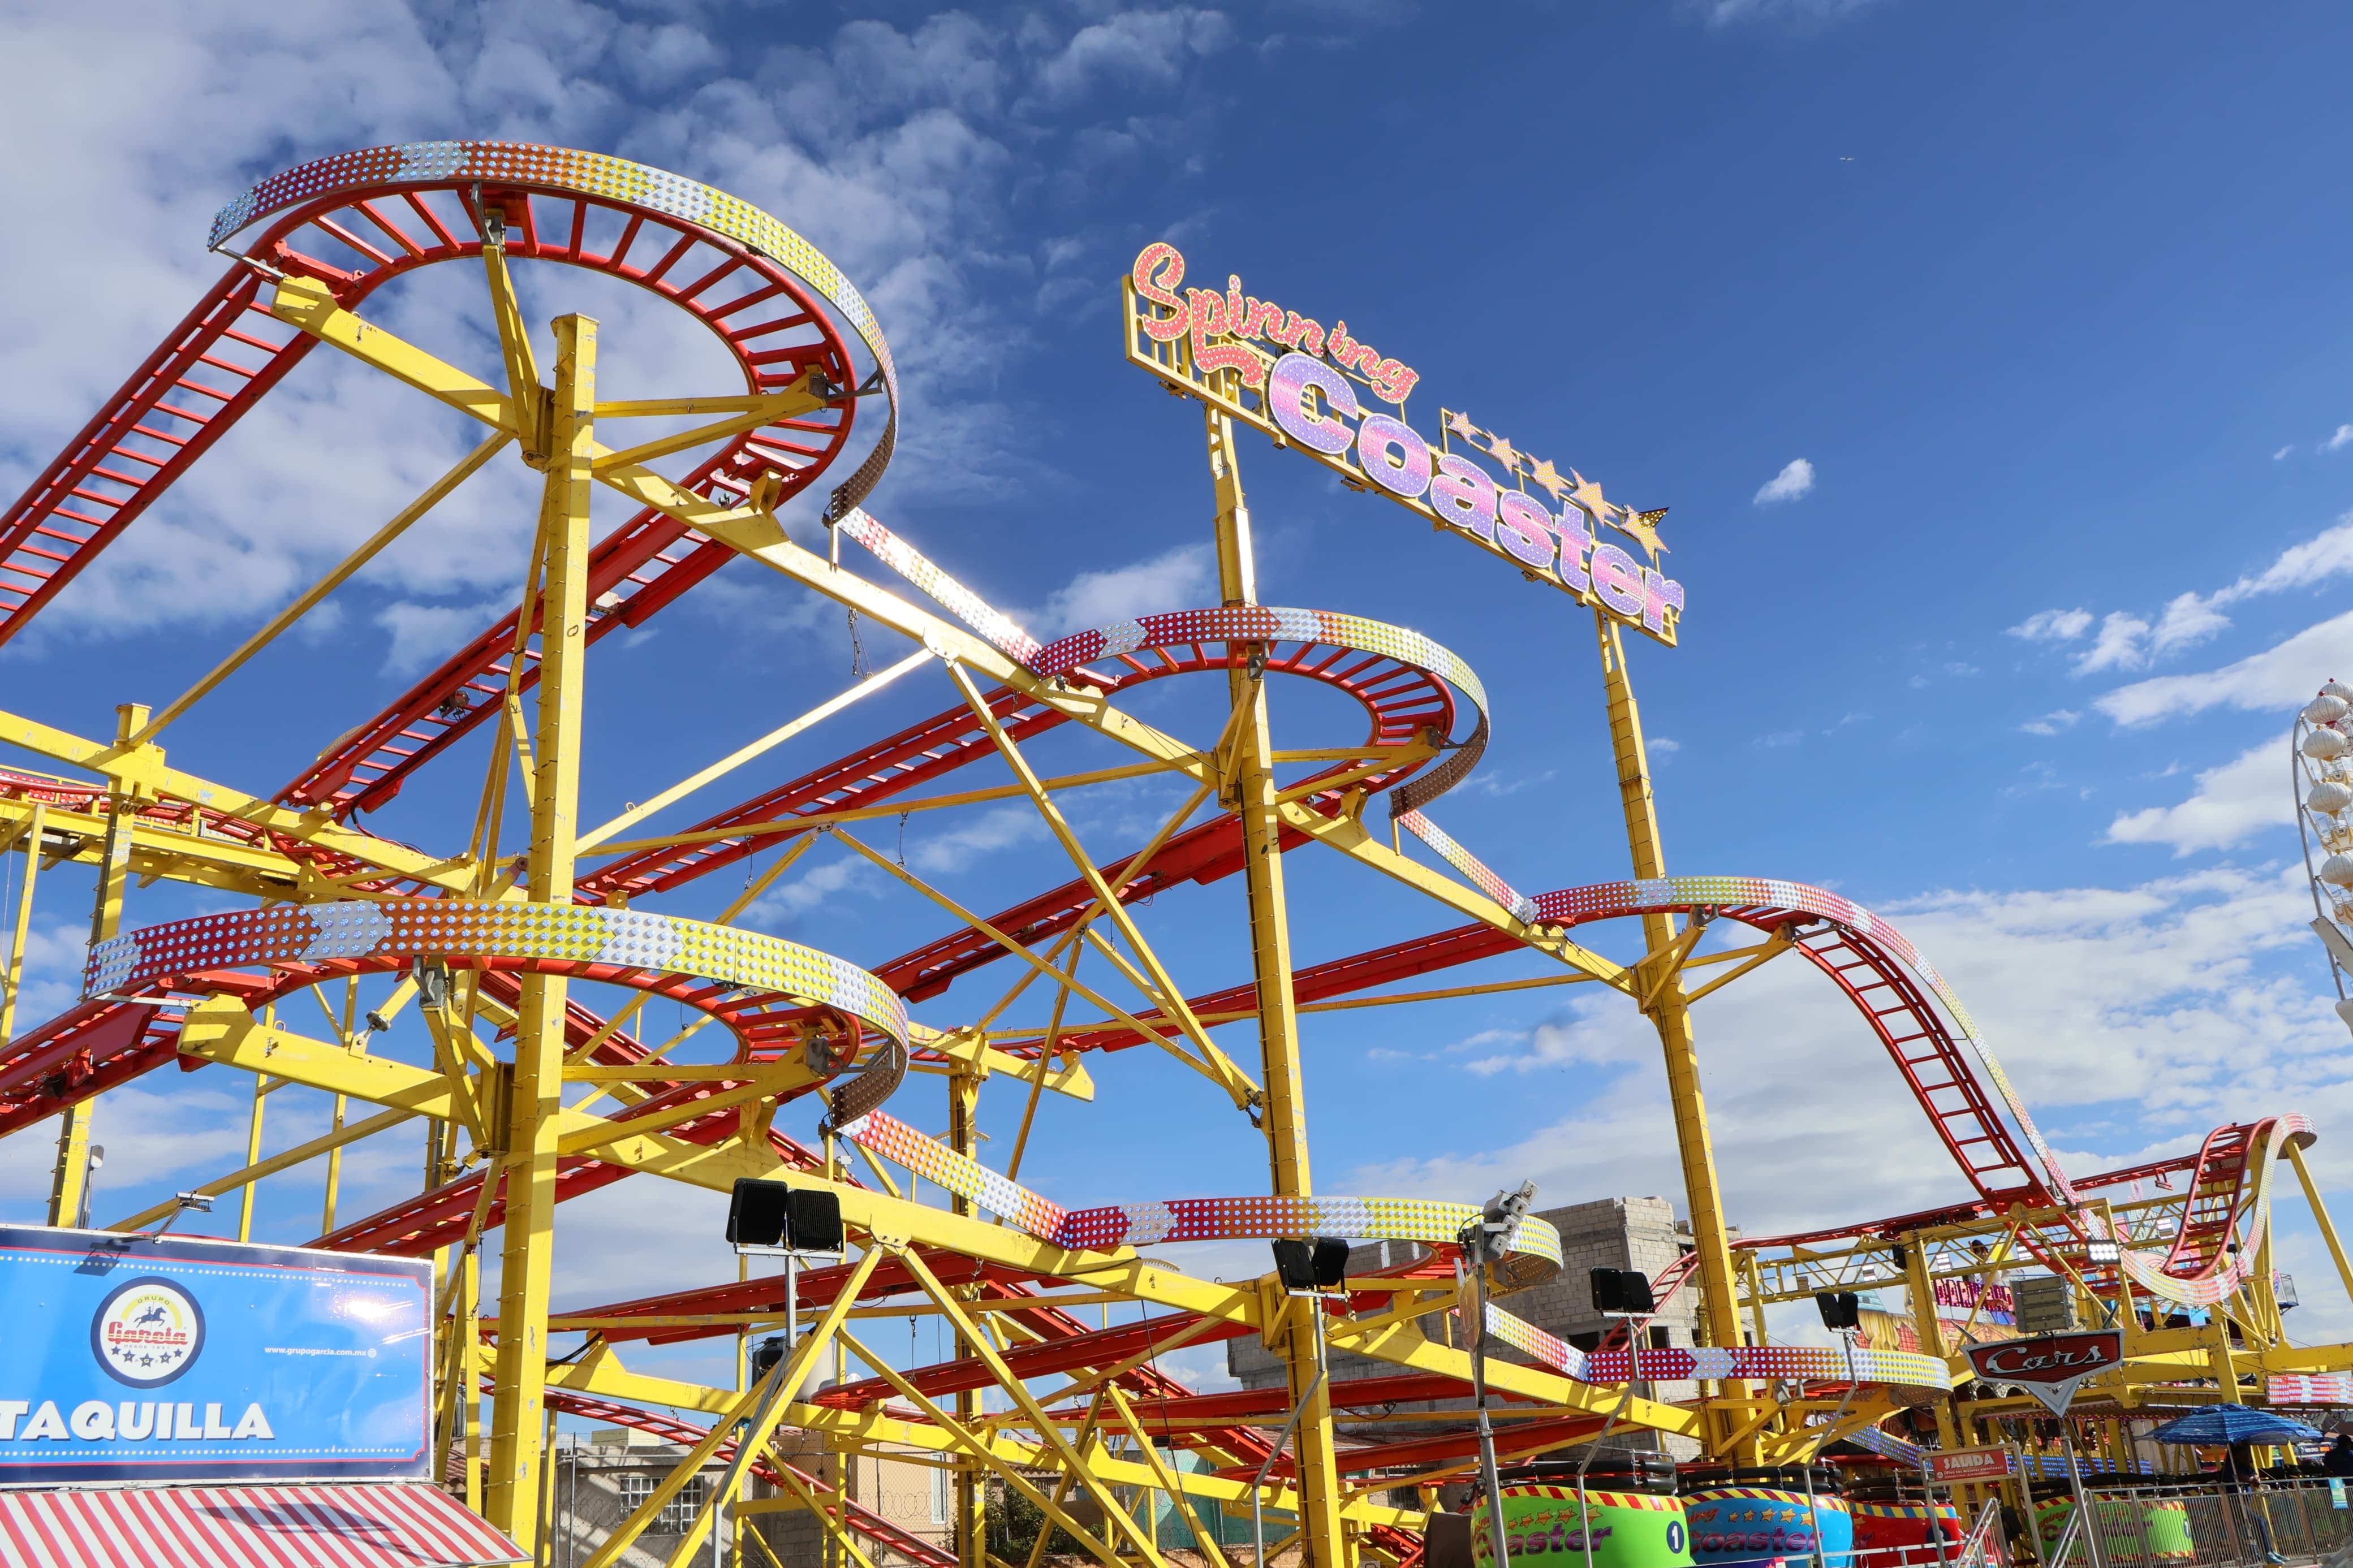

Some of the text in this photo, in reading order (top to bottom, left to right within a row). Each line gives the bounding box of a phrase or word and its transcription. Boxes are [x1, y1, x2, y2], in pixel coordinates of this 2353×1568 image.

[1133, 242, 1420, 404] Spinning
[1269, 352, 1684, 634] Coaster
[137, 1295, 170, 1306] GRUPO
[265, 1346, 367, 1357] www.grupogarcia.com.mx
[1985, 1345, 2108, 1374] Cars
[0, 1400, 275, 1440] TAQUILLA
[1943, 1453, 1995, 1470] SALIDA
[1671, 1526, 1679, 1549] 1
